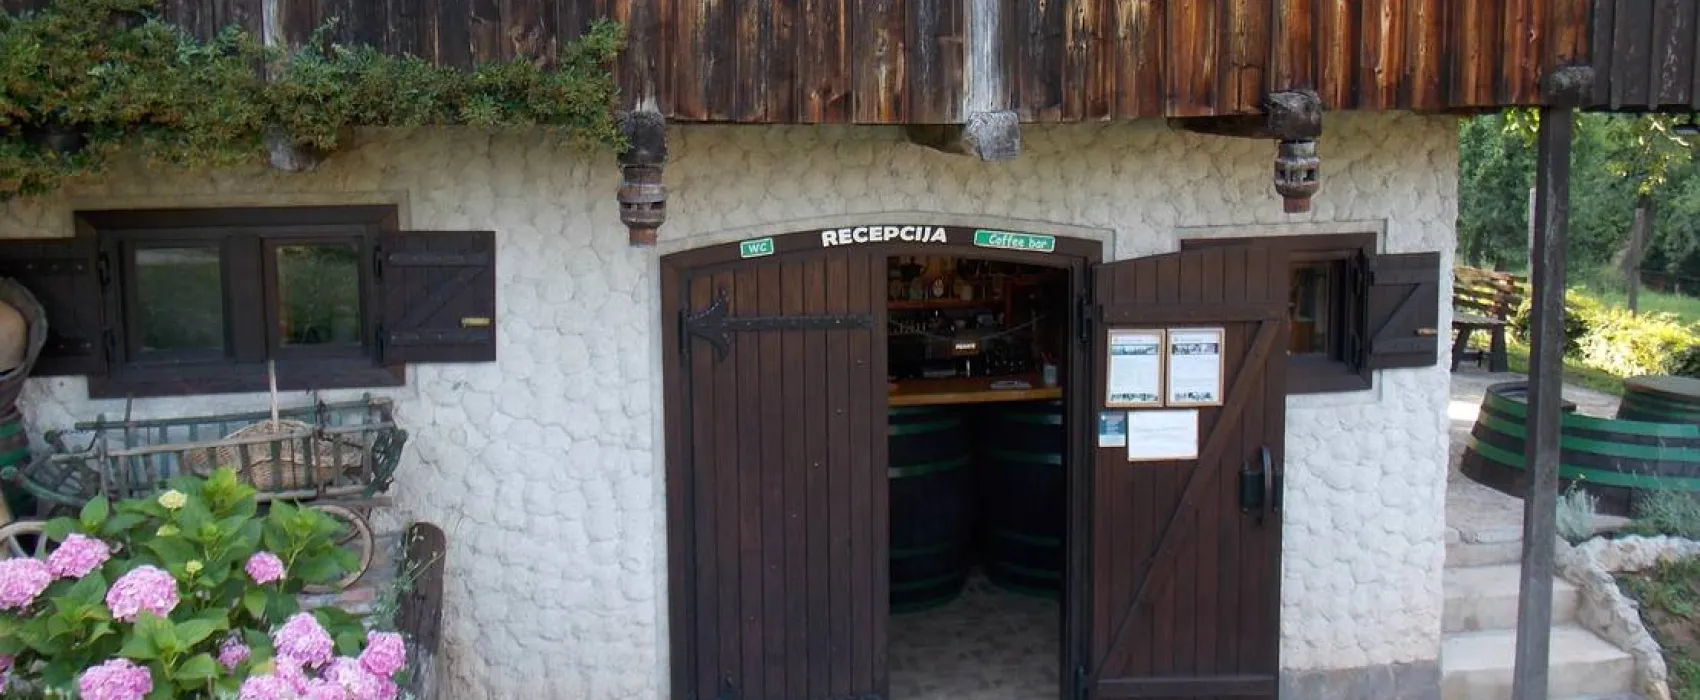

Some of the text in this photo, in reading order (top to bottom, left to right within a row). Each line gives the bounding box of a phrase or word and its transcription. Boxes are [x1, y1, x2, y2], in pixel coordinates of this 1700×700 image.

[821, 226, 947, 247] RECEPCIJA
[1028, 236, 1047, 249] bar
[748, 242, 767, 253] WC
